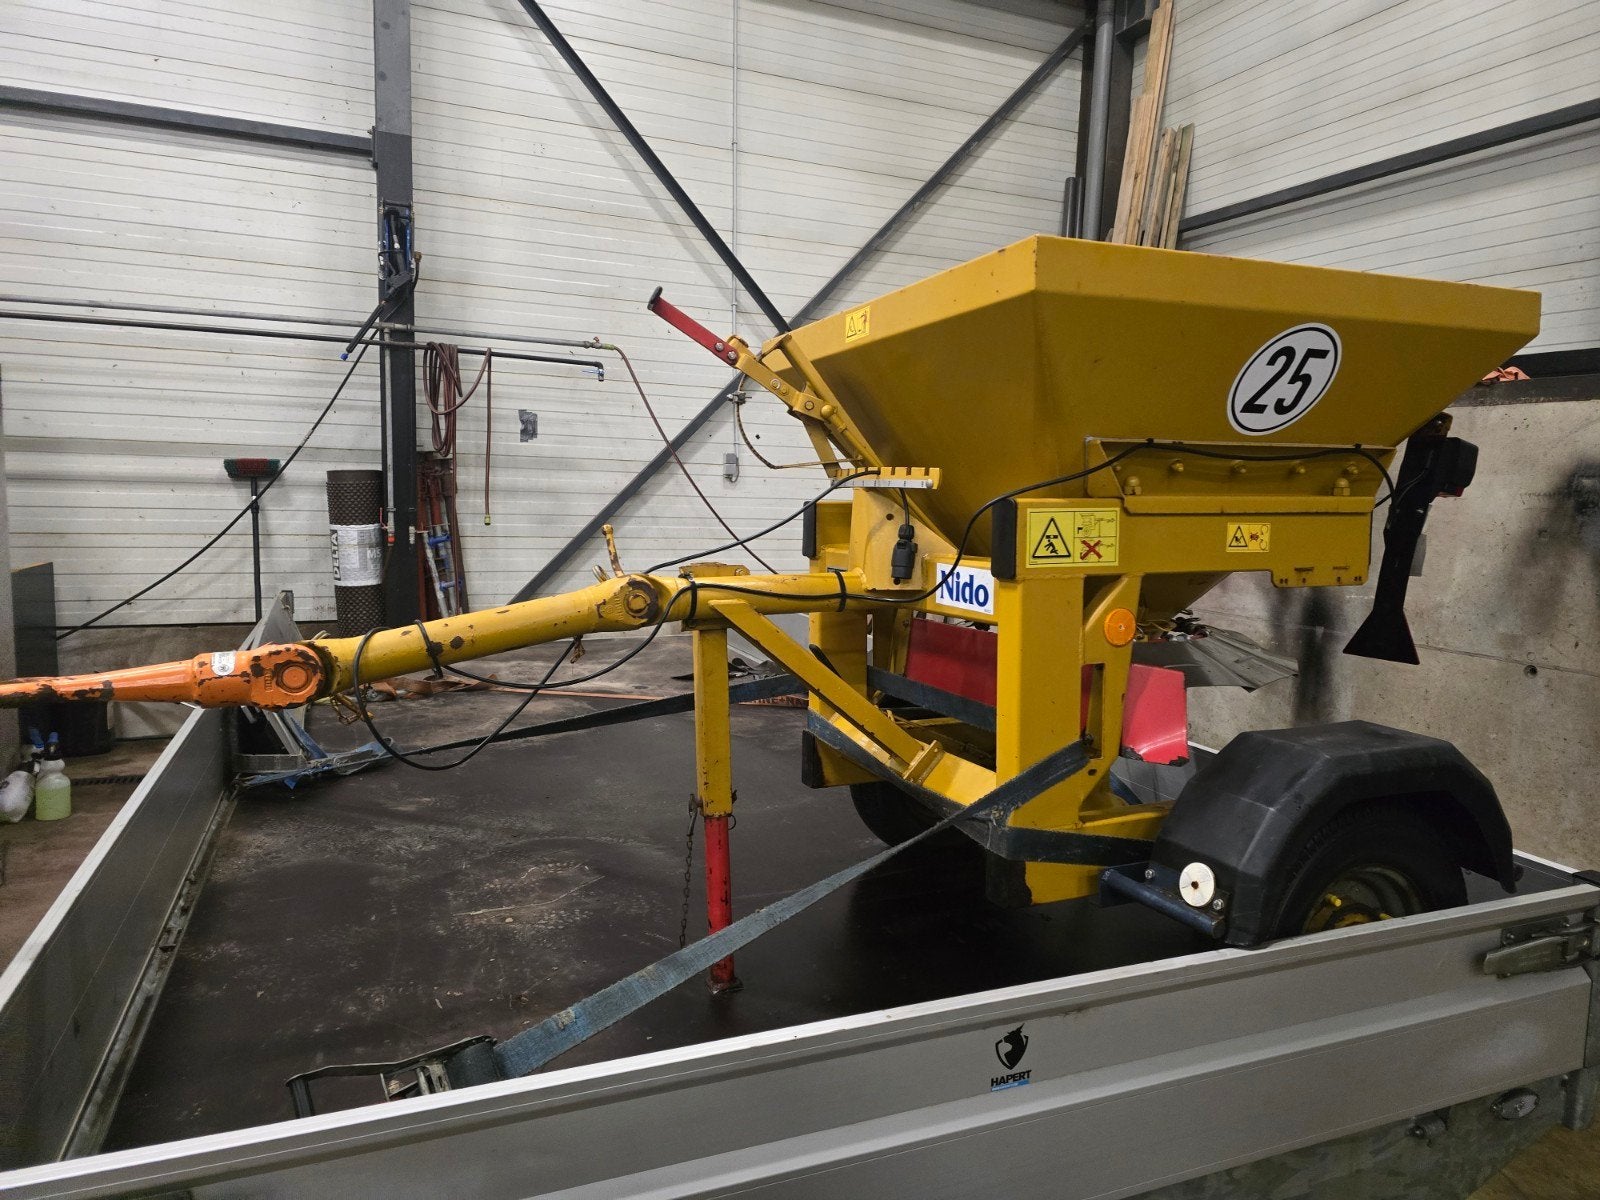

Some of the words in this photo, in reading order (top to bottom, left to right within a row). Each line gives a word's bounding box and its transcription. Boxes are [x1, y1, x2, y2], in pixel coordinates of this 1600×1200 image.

[1240, 345, 1330, 416] 25
[331, 532, 341, 580] DELTA
[939, 570, 989, 607] Nido
[990, 1069, 1032, 1087] HAPERT
